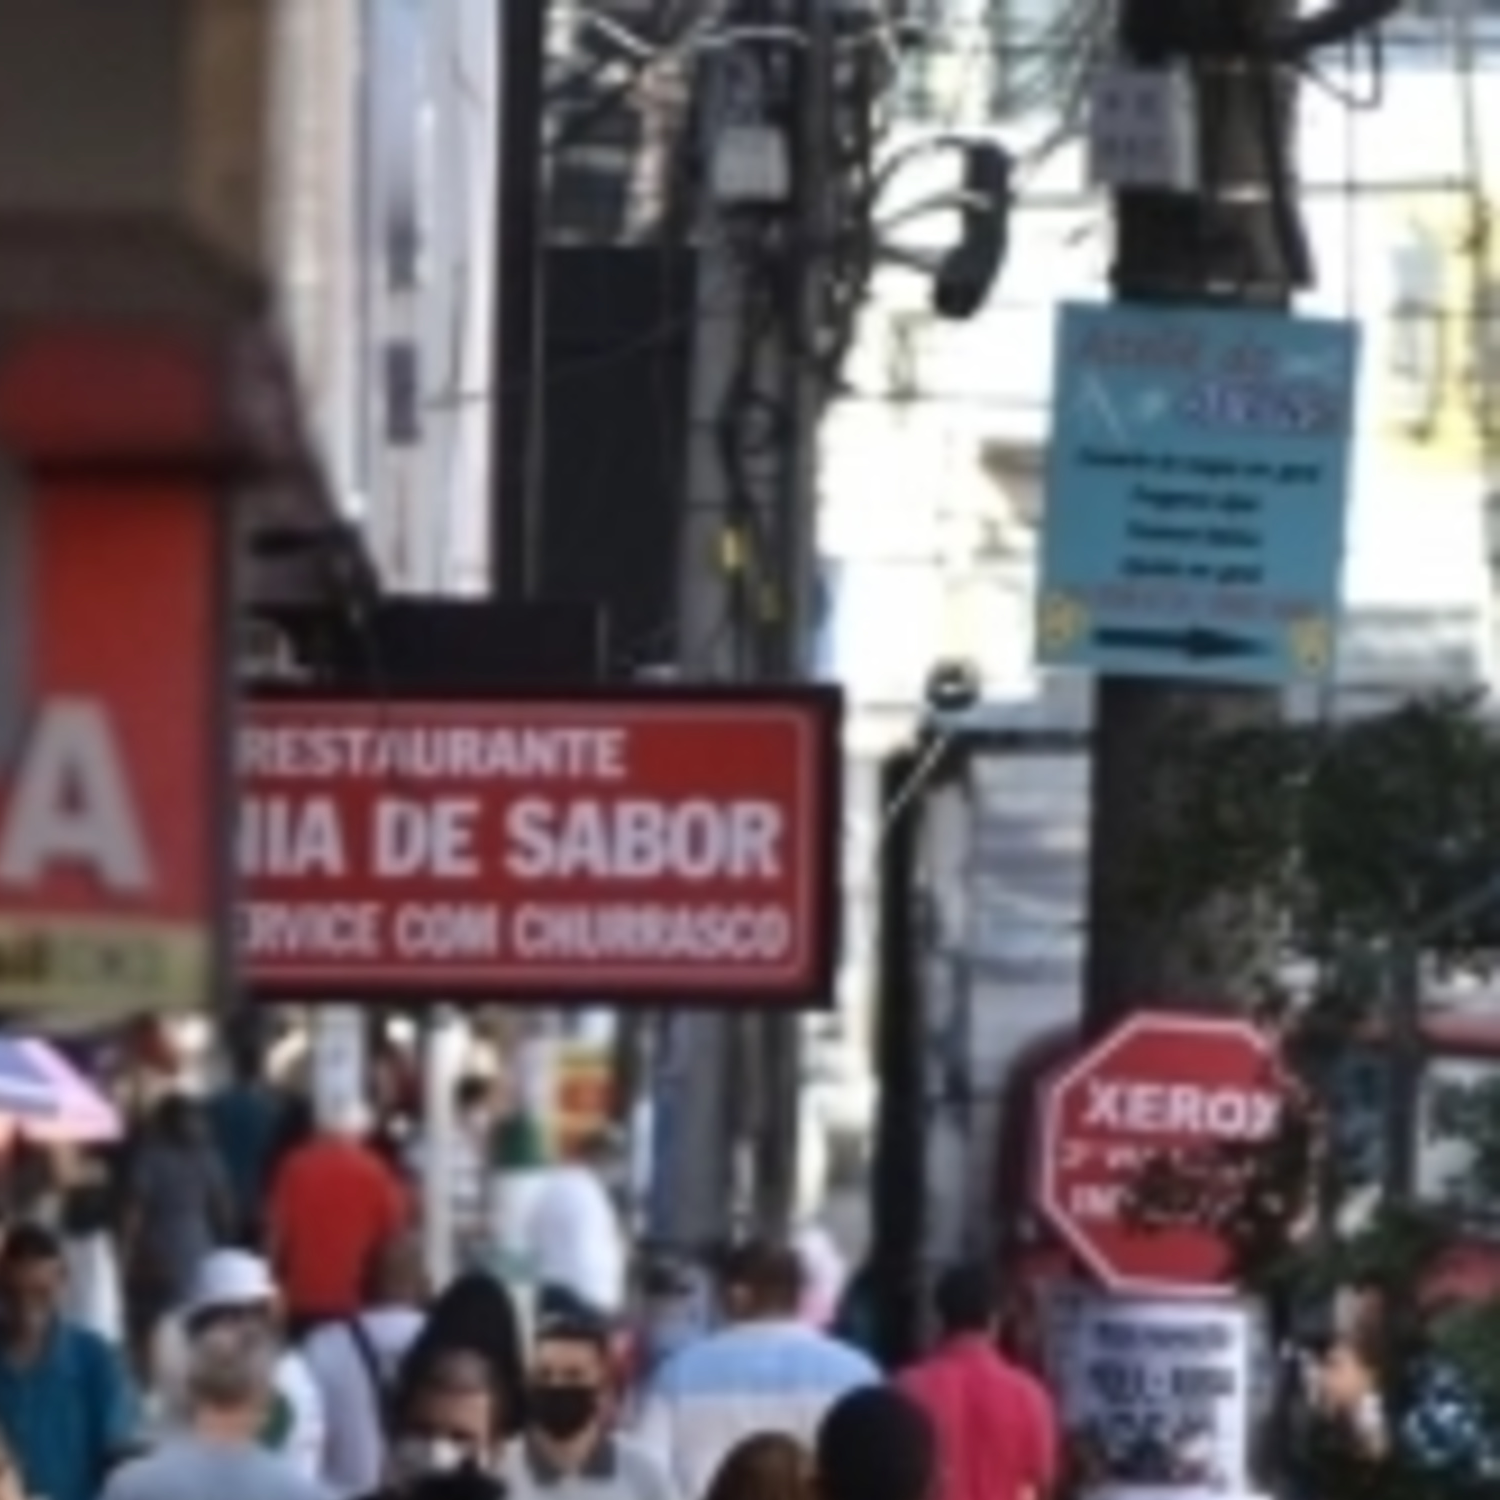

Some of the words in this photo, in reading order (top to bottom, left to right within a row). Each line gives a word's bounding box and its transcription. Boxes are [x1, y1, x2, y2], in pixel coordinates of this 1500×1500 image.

[238, 728, 628, 778] RESTAURANTE
[374, 800, 480, 878] DE
[505, 800, 784, 880] SABOR
[395, 904, 497, 957] COM
[513, 906, 792, 960] CHURRASCO
